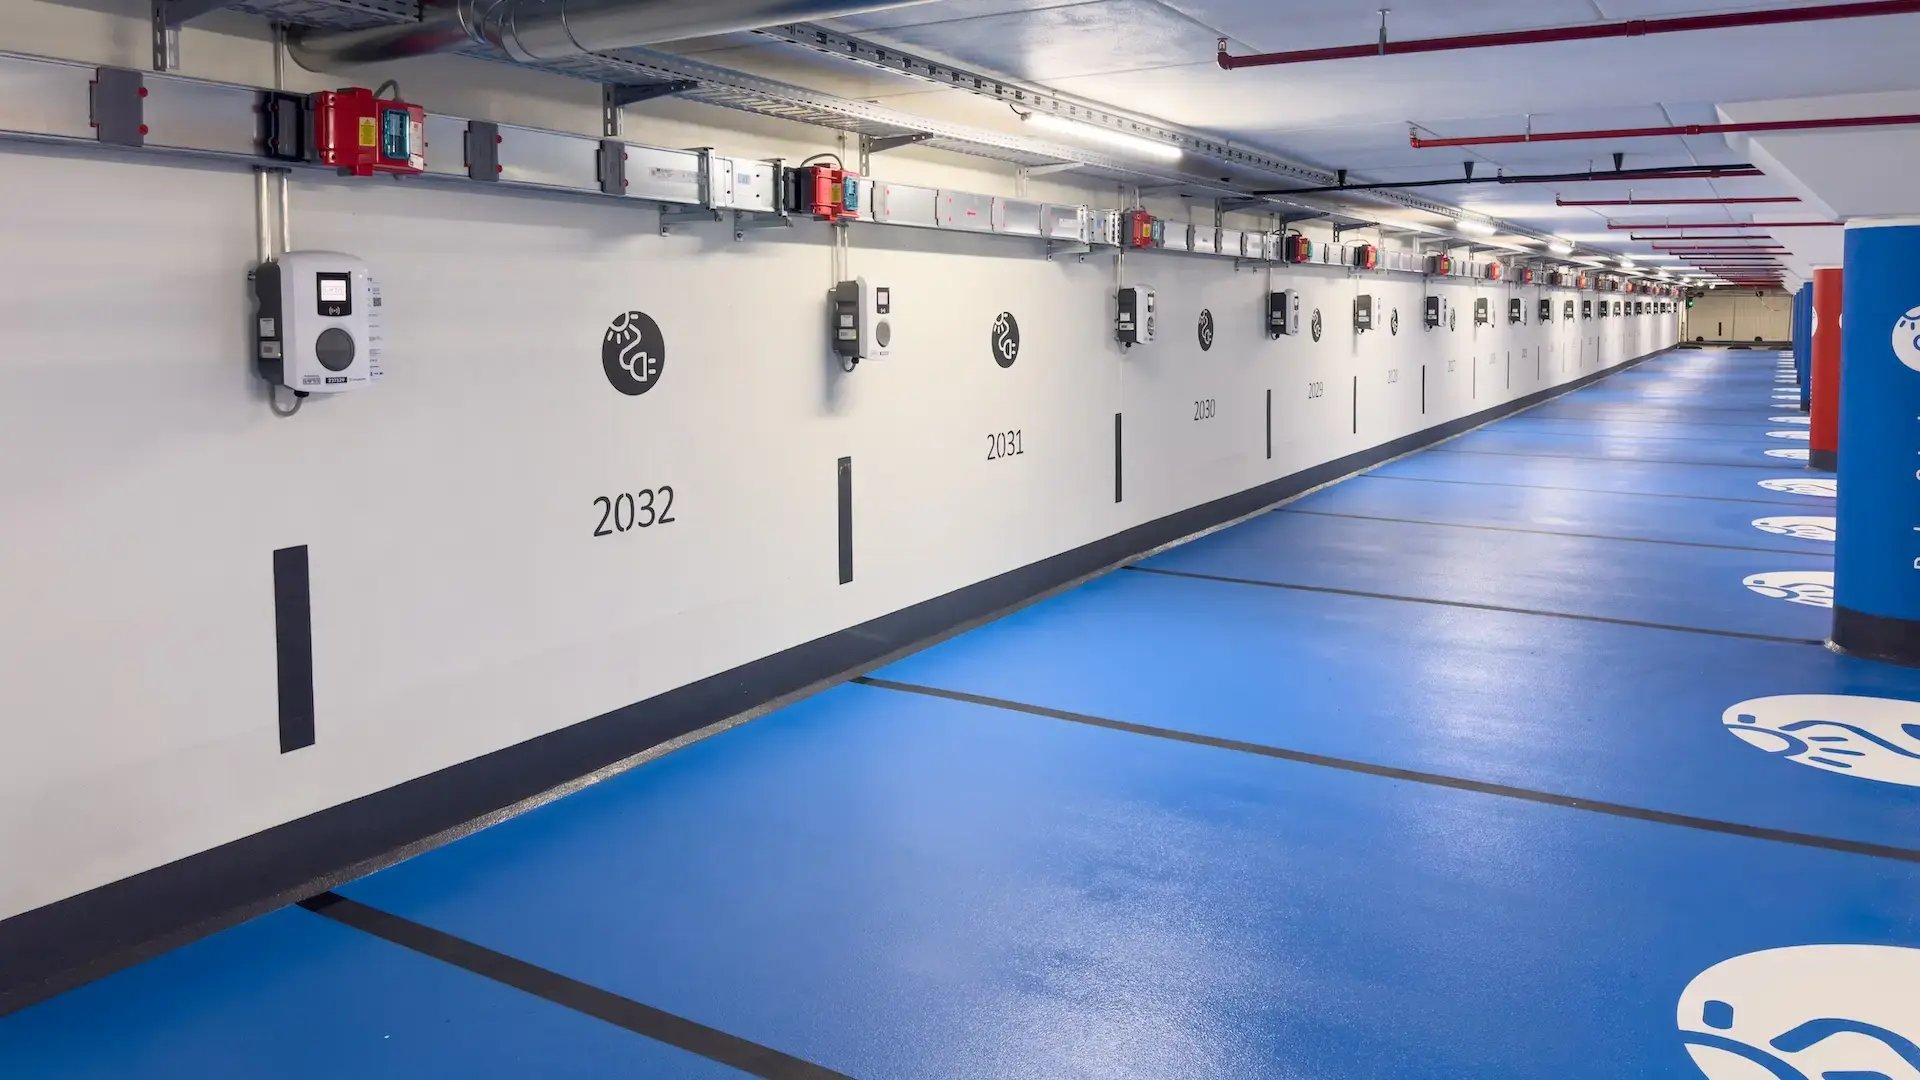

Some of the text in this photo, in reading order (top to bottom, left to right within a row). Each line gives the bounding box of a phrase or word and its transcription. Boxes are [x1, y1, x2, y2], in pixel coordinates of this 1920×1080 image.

[1308, 381, 1324, 399] 2029
[1194, 399, 1216, 420] 2030
[987, 429, 1024, 460] 2031
[593, 485, 675, 537] 2032
